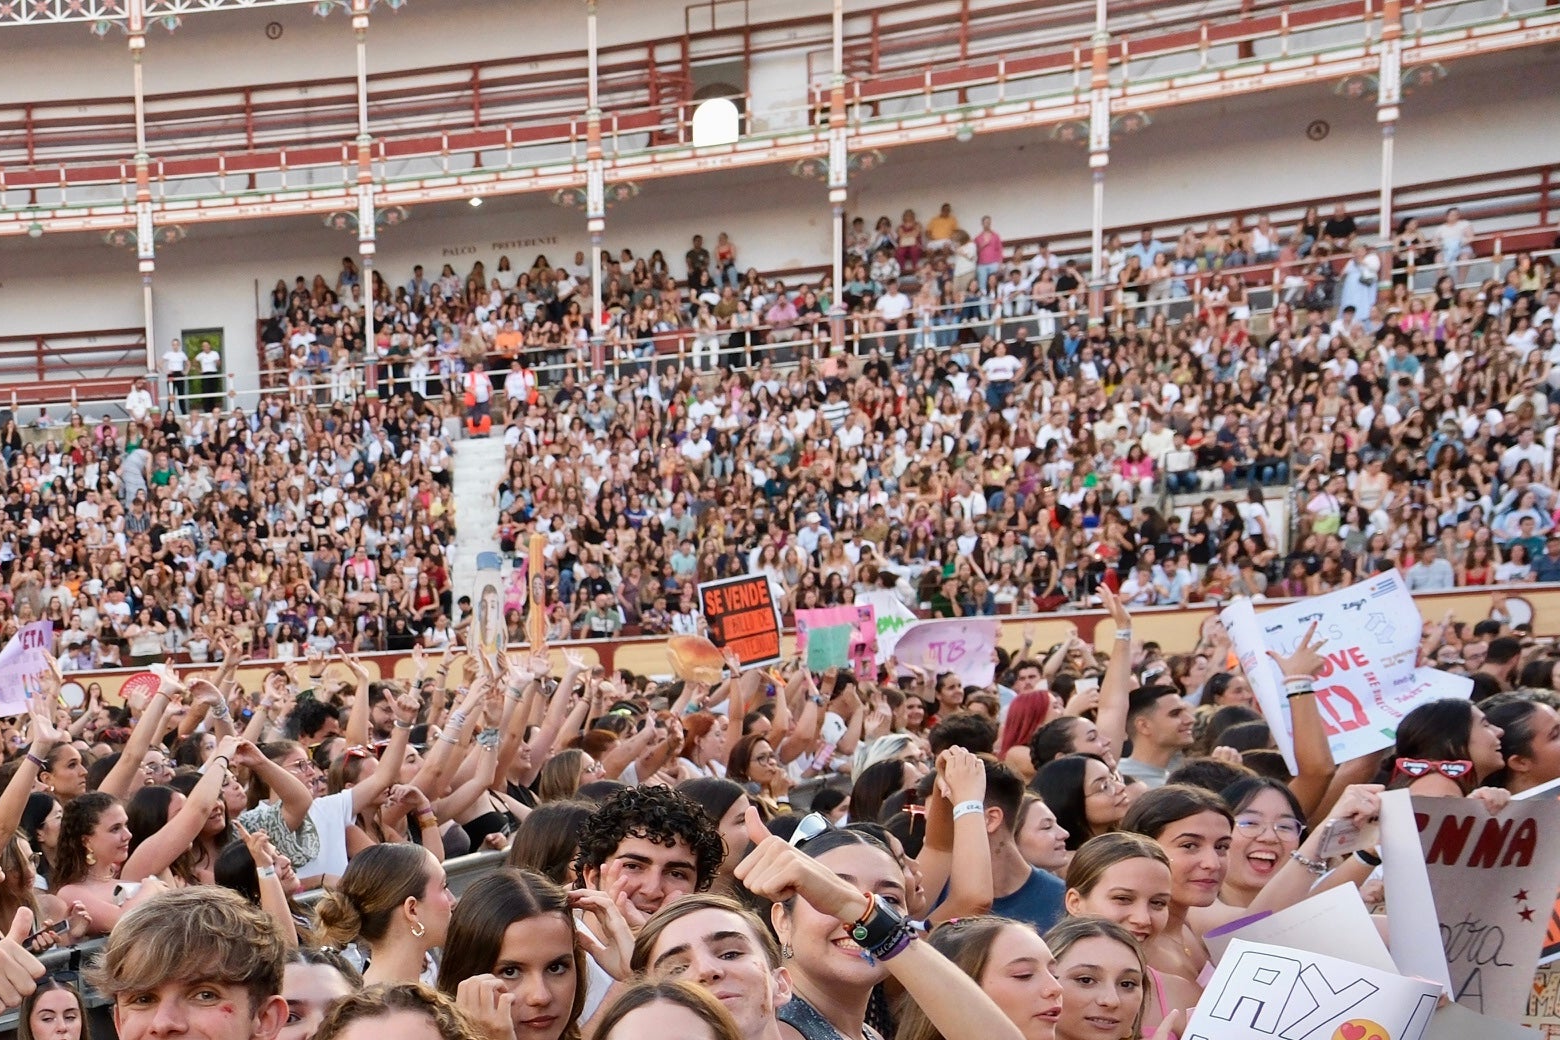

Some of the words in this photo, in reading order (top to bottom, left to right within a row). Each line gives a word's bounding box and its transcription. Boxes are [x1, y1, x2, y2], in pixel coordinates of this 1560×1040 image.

[705, 590, 724, 615] SE
[724, 580, 770, 611] VENDE
[1314, 646, 1370, 681] OVE
